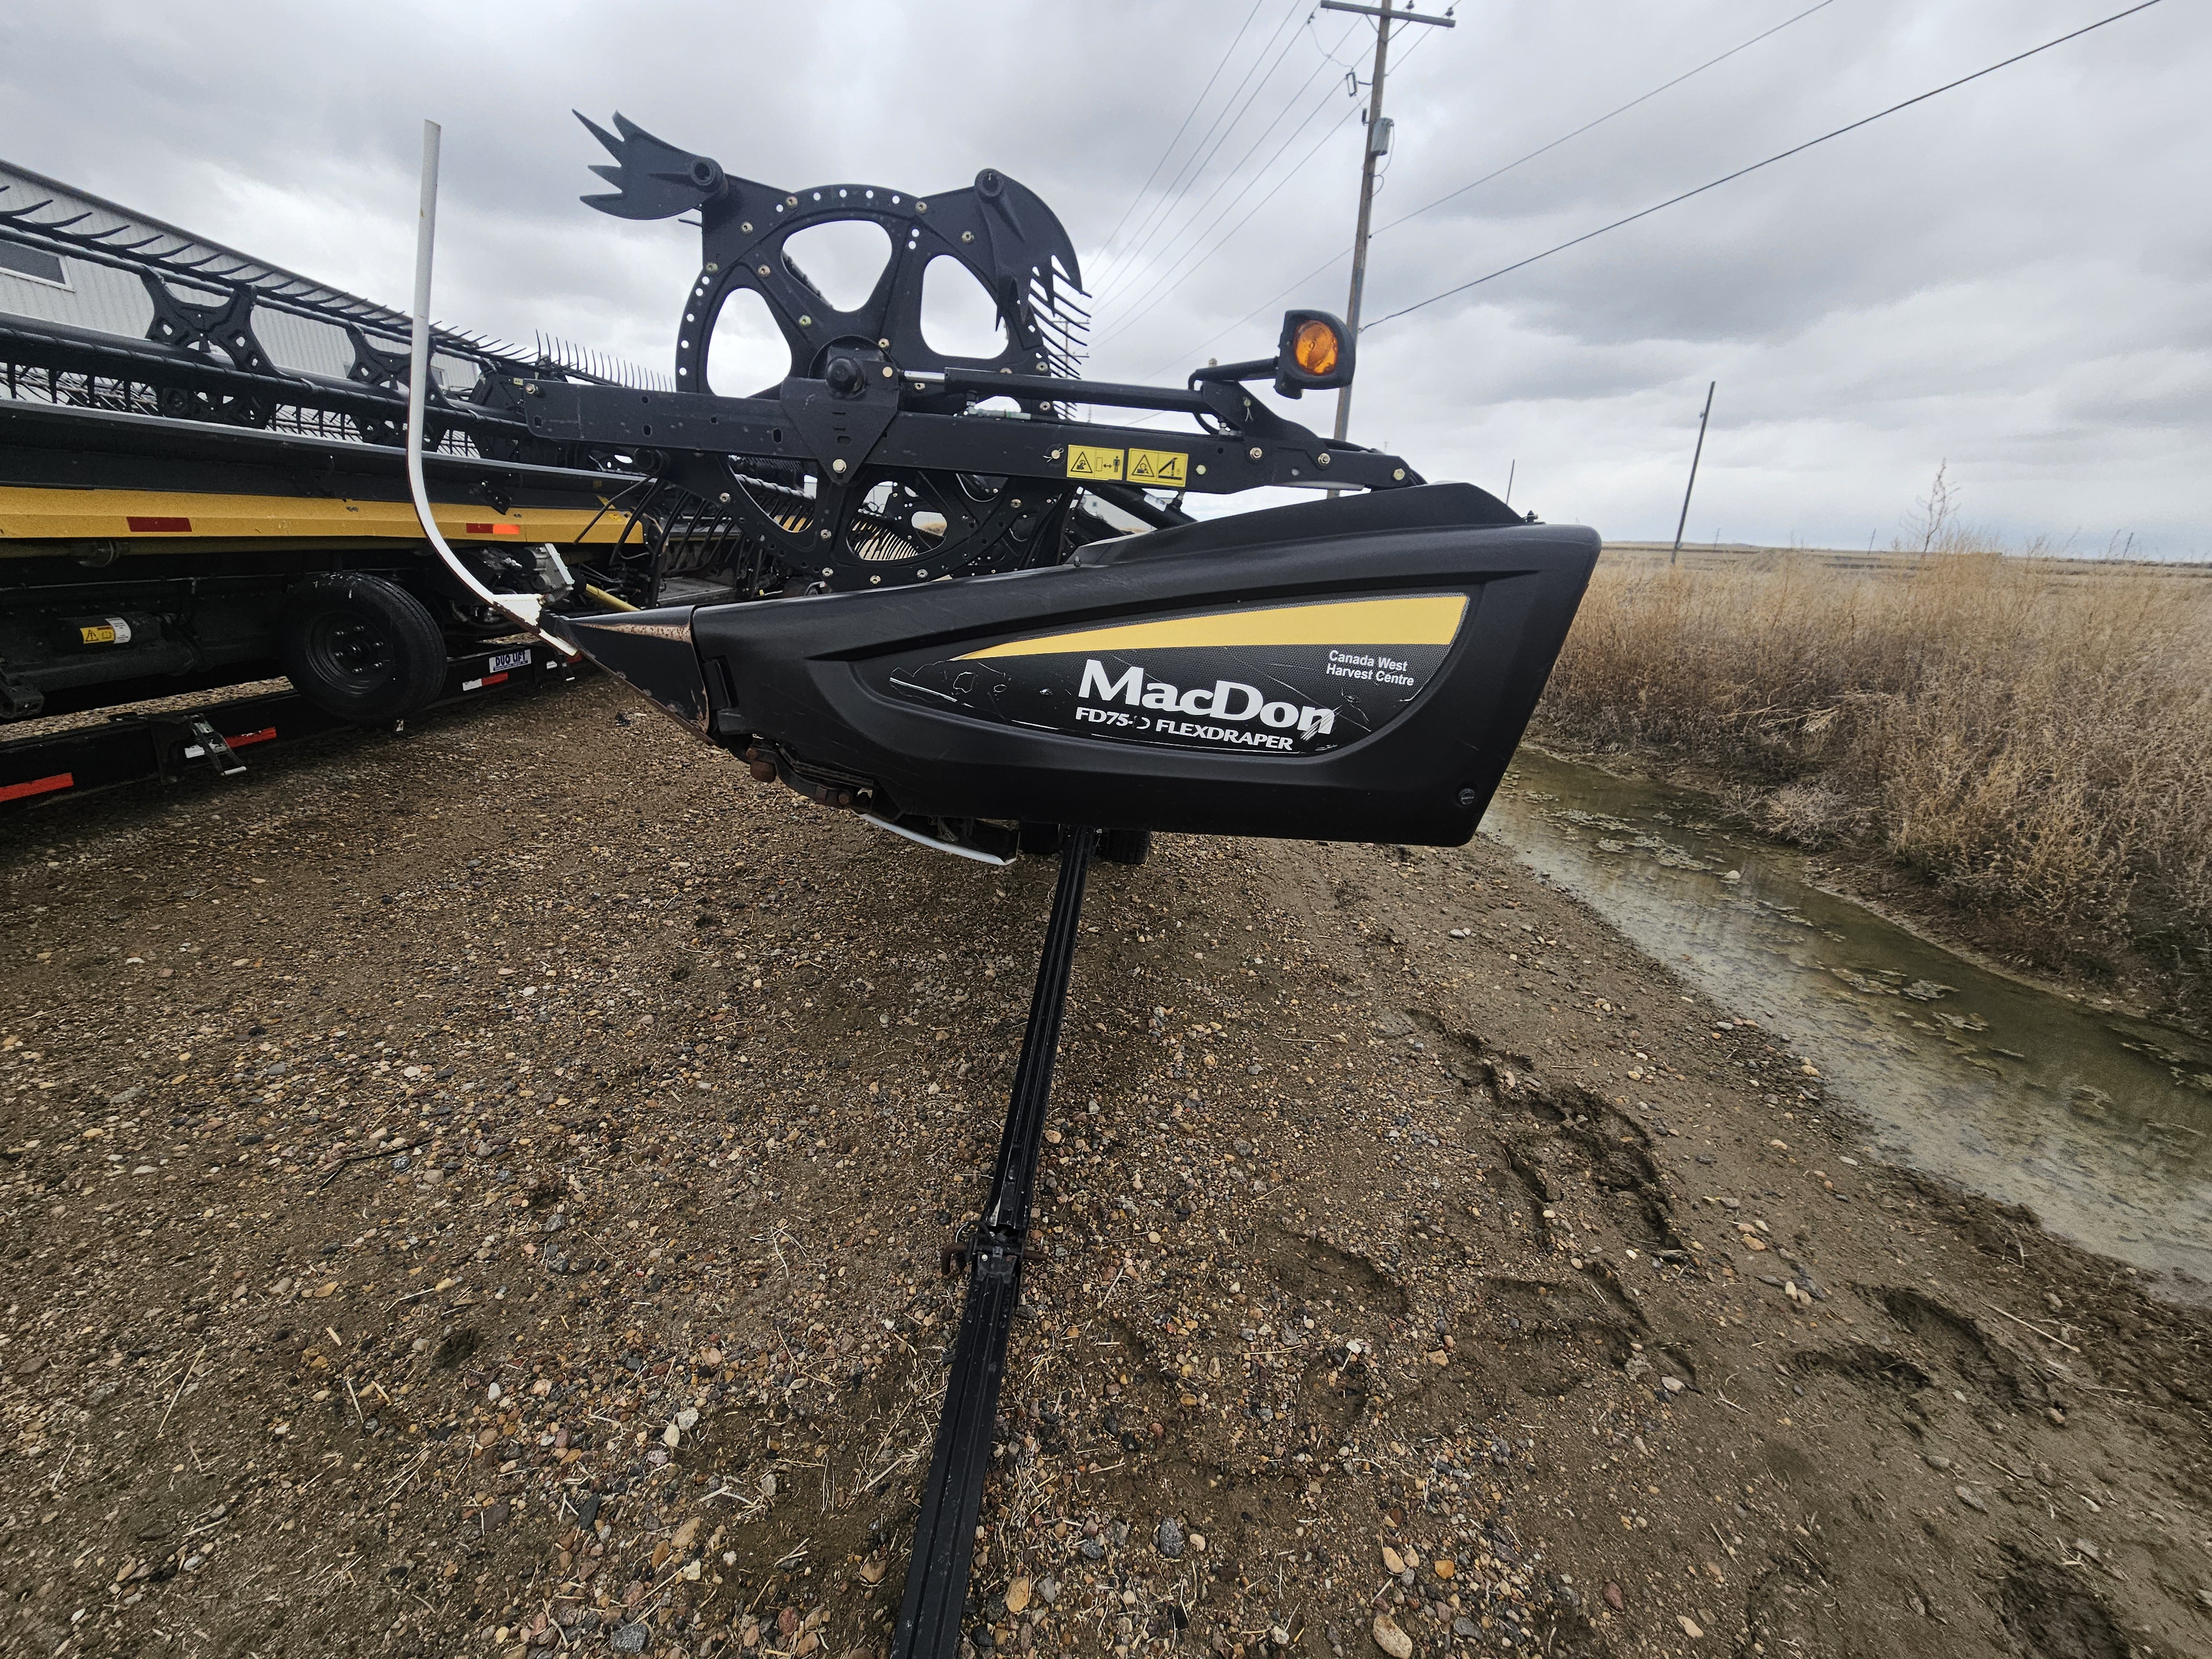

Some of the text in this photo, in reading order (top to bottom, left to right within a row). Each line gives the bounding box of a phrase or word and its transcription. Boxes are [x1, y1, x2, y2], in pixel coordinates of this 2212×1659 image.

[495, 655, 510, 666] DUO
[513, 651, 525, 663] LIFT
[1329, 650, 1408, 671] Canada West
[1326, 663, 1414, 686] Harvest Centre
[1078, 659, 1335, 734] MacDon
[1156, 719, 1293, 750] FLEXDRAPER
